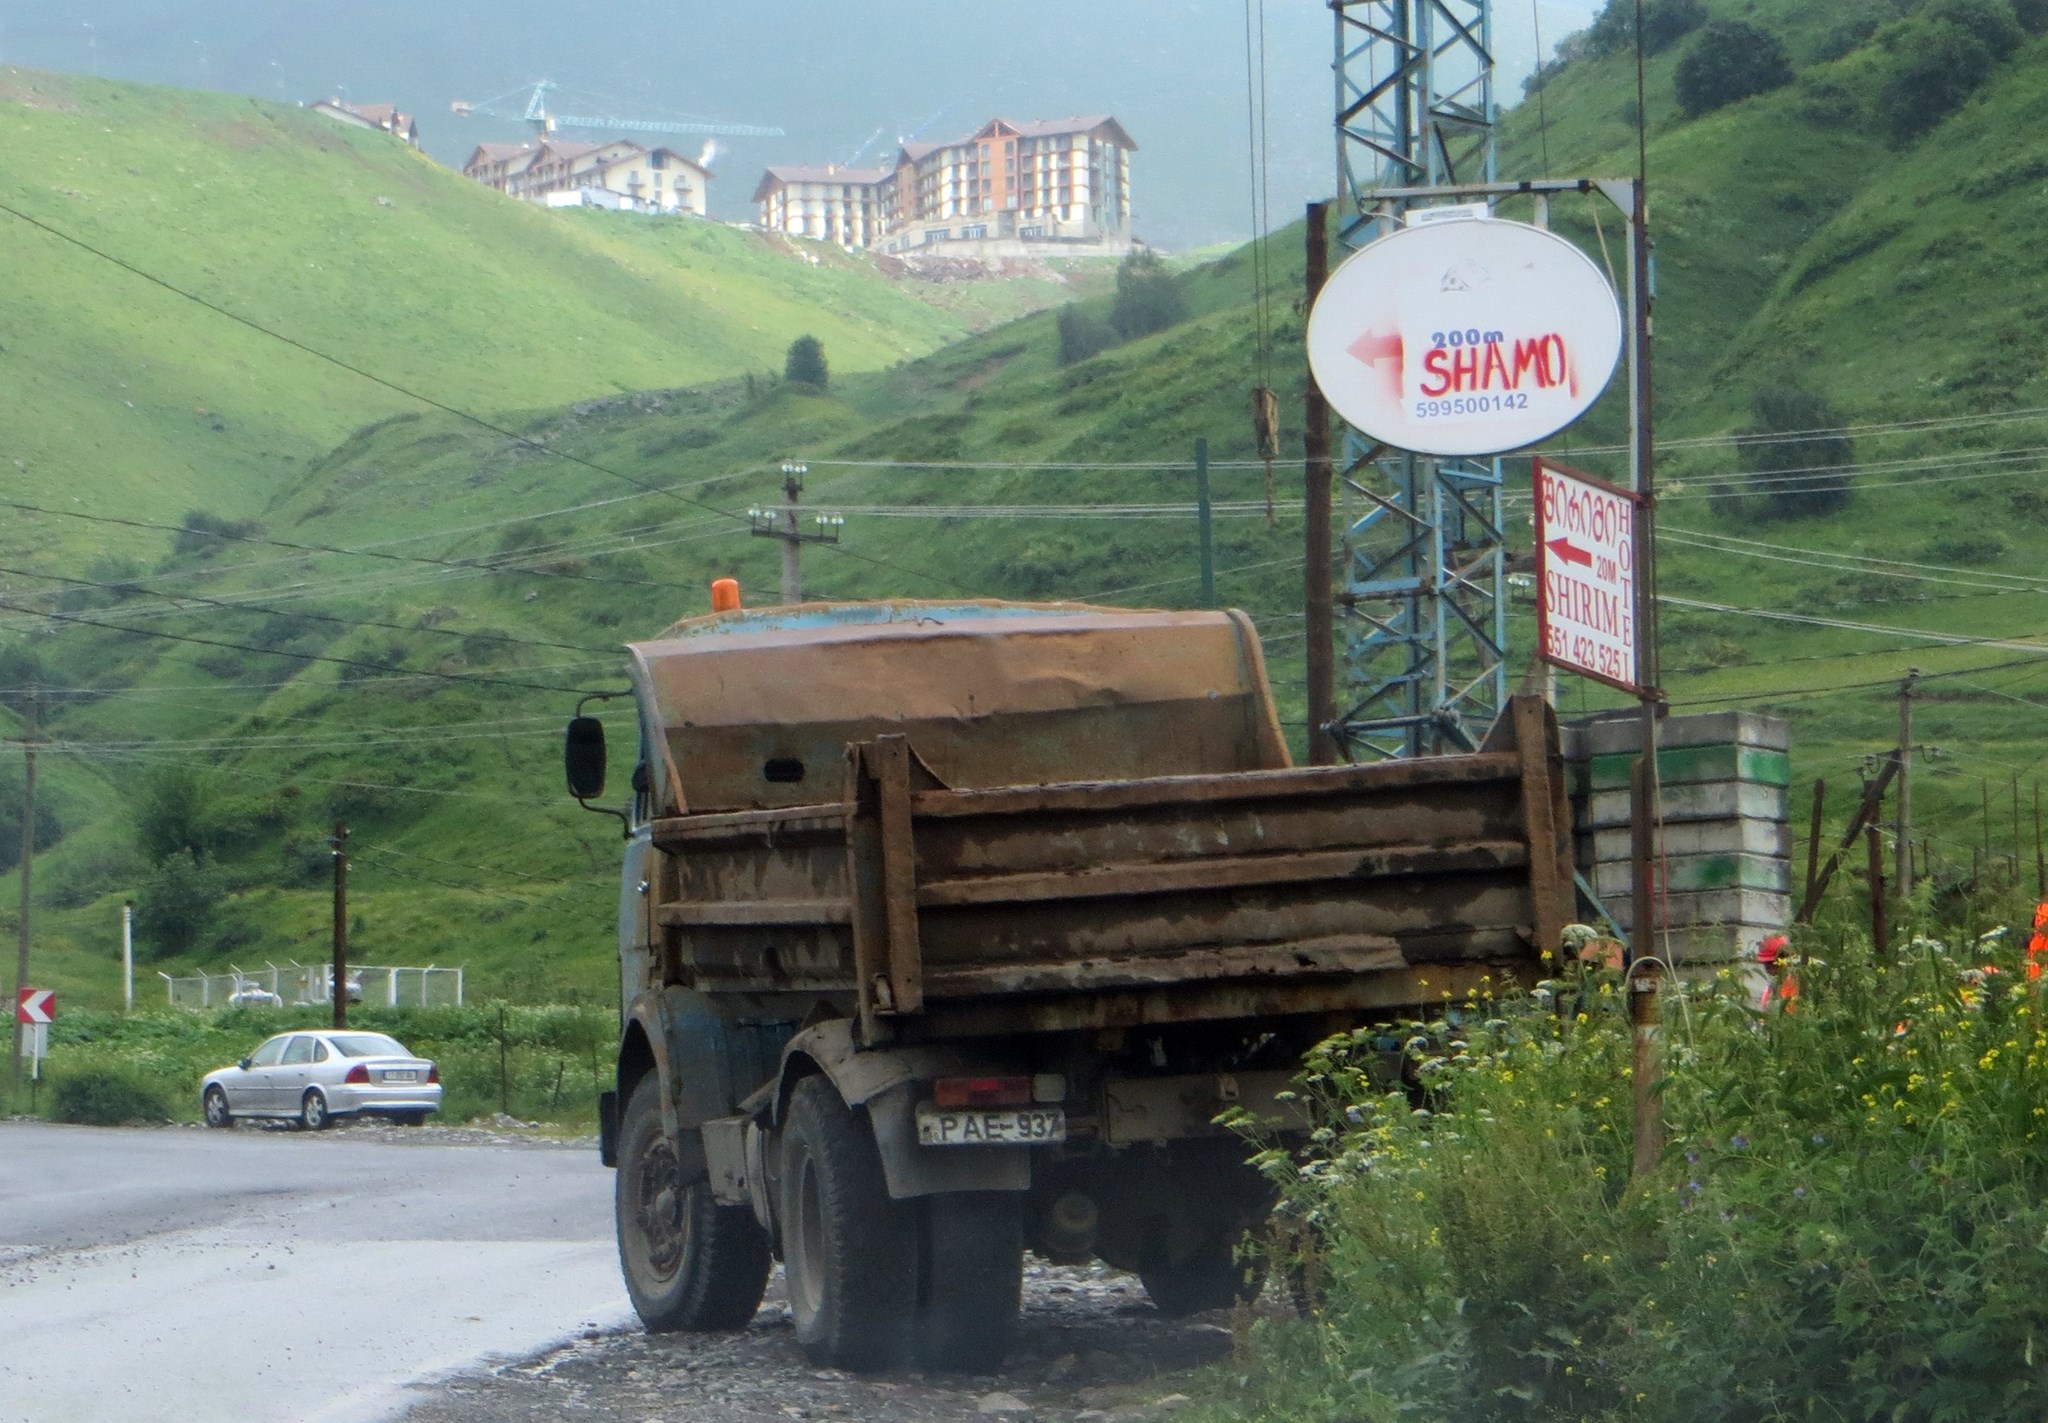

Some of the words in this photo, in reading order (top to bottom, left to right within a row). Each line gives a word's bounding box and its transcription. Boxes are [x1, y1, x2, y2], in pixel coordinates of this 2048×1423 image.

[1431, 328, 1505, 349] 200m
[1420, 333, 1567, 397] SHAMO
[1416, 393, 1529, 418] 599500142
[1541, 474, 1617, 549] შირიმი
[1597, 555, 1616, 585] 20M
[1546, 570, 1619, 638] SHIRIM
[1616, 501, 1632, 685] HOTEL
[1573, 634, 1595, 669] 423
[1599, 643, 1620, 678] 525
[939, 1112, 1061, 1141] PAE-937
